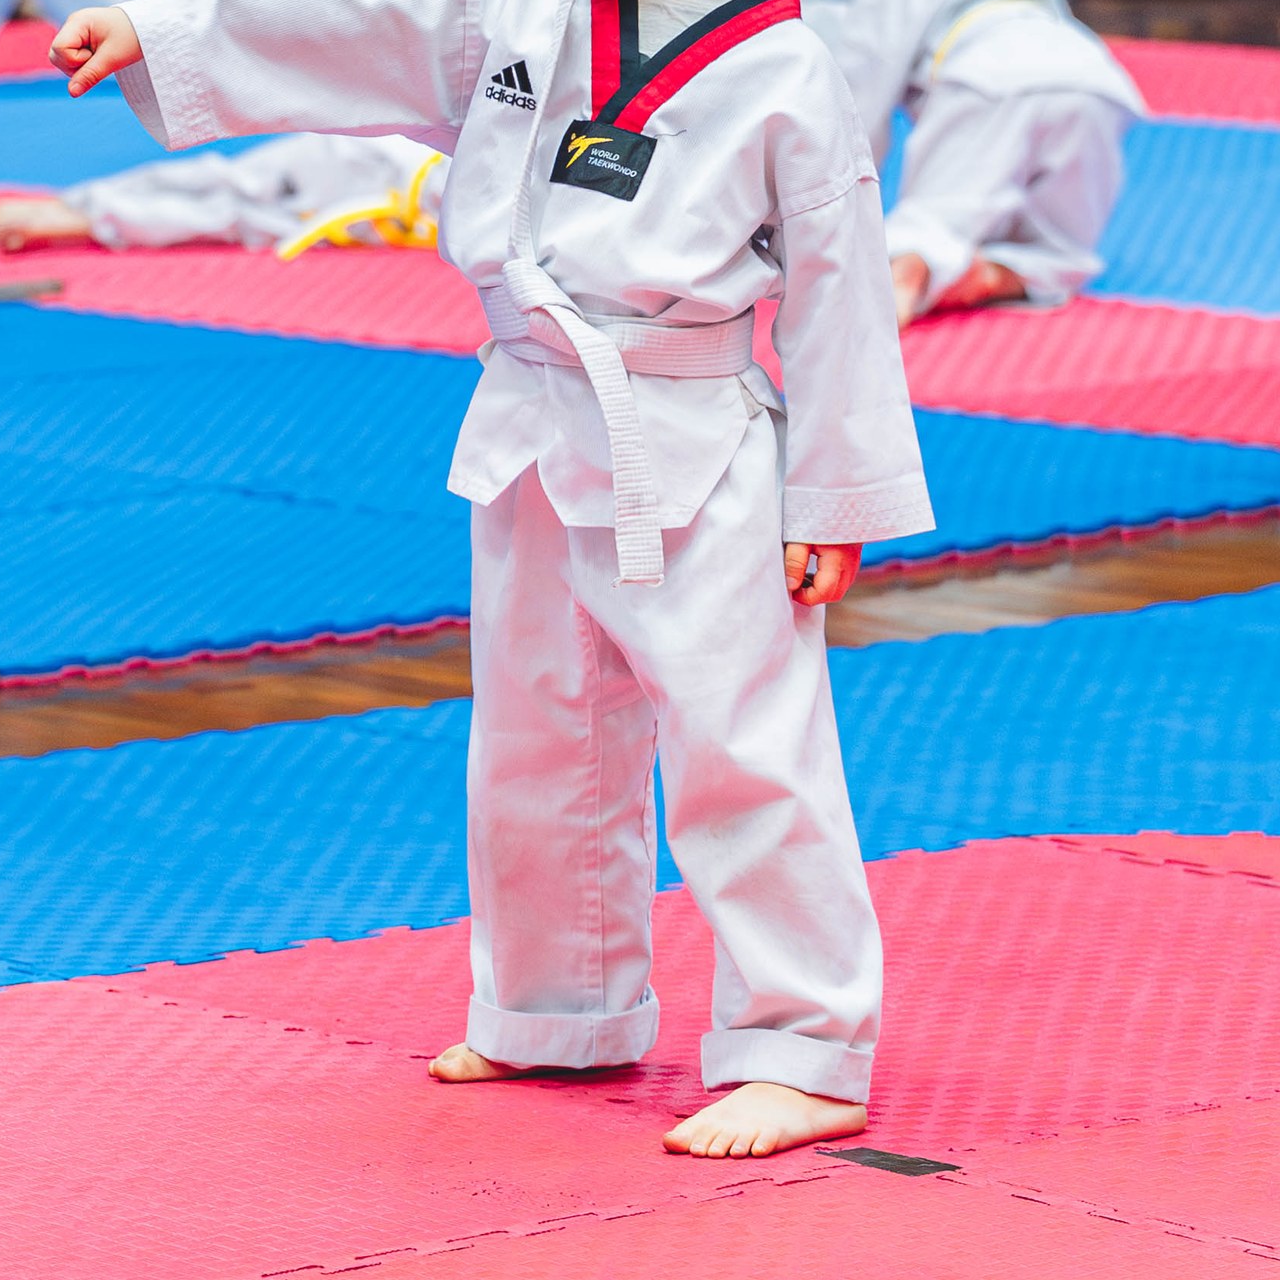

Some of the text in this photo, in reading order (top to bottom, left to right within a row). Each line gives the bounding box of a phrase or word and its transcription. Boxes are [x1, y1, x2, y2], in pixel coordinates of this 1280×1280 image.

[485, 86, 537, 111] adidas
[591, 147, 620, 162] WORLD
[587, 156, 638, 178] TAEKWONDO
